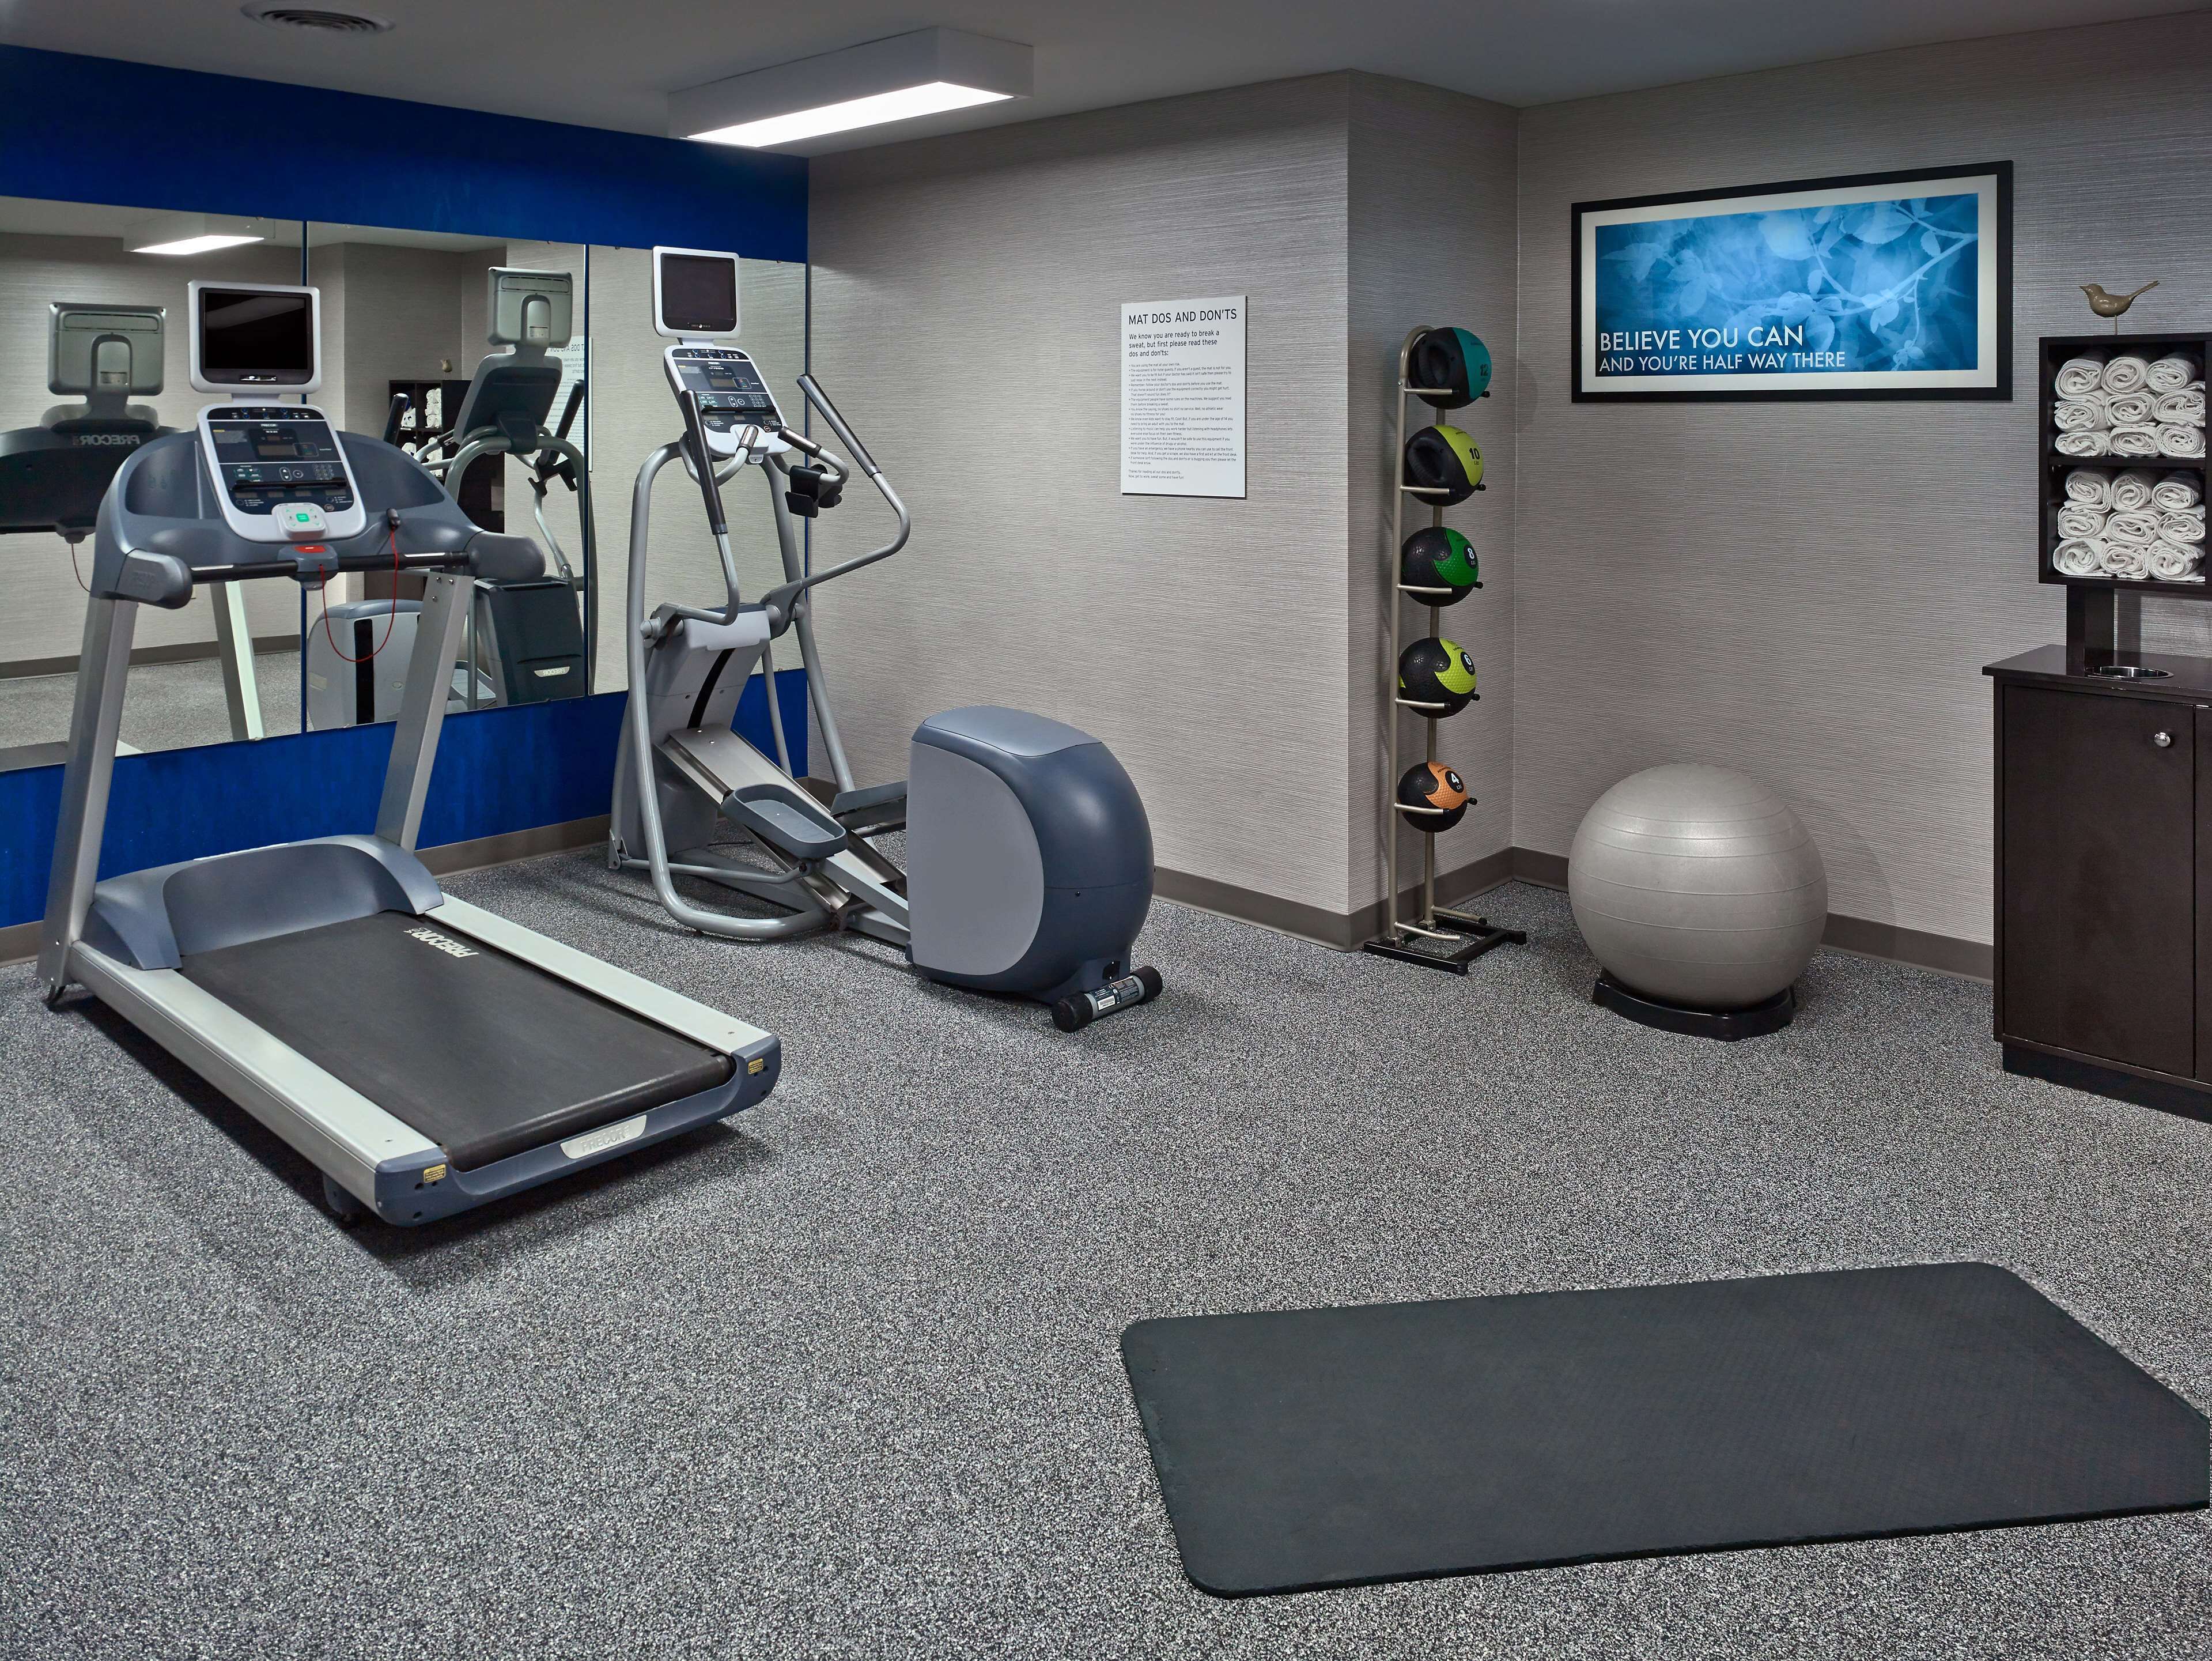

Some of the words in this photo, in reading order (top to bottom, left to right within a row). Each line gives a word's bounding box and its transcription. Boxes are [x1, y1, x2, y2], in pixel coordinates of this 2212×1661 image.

[1129, 314, 1148, 325] MAT
[1152, 312, 1171, 323] DOS
[1175, 311, 1196, 322] AND
[1174, 331, 1190, 339] ready
[1601, 330, 1681, 352] BELIEVE
[1688, 327, 1738, 349] YOU
[1748, 325, 1803, 347] CAN
[1600, 357, 1635, 372] AND
[1639, 354, 1697, 371] YOU'RE
[1703, 354, 1743, 369] HALF
[1748, 353, 1787, 368] WAY
[1792, 352, 1846, 368] THERE
[1469, 447, 1480, 460] 10
[1468, 548, 1474, 559] 8
[1464, 654, 1472, 666] 6
[1451, 773, 1459, 784] 4
